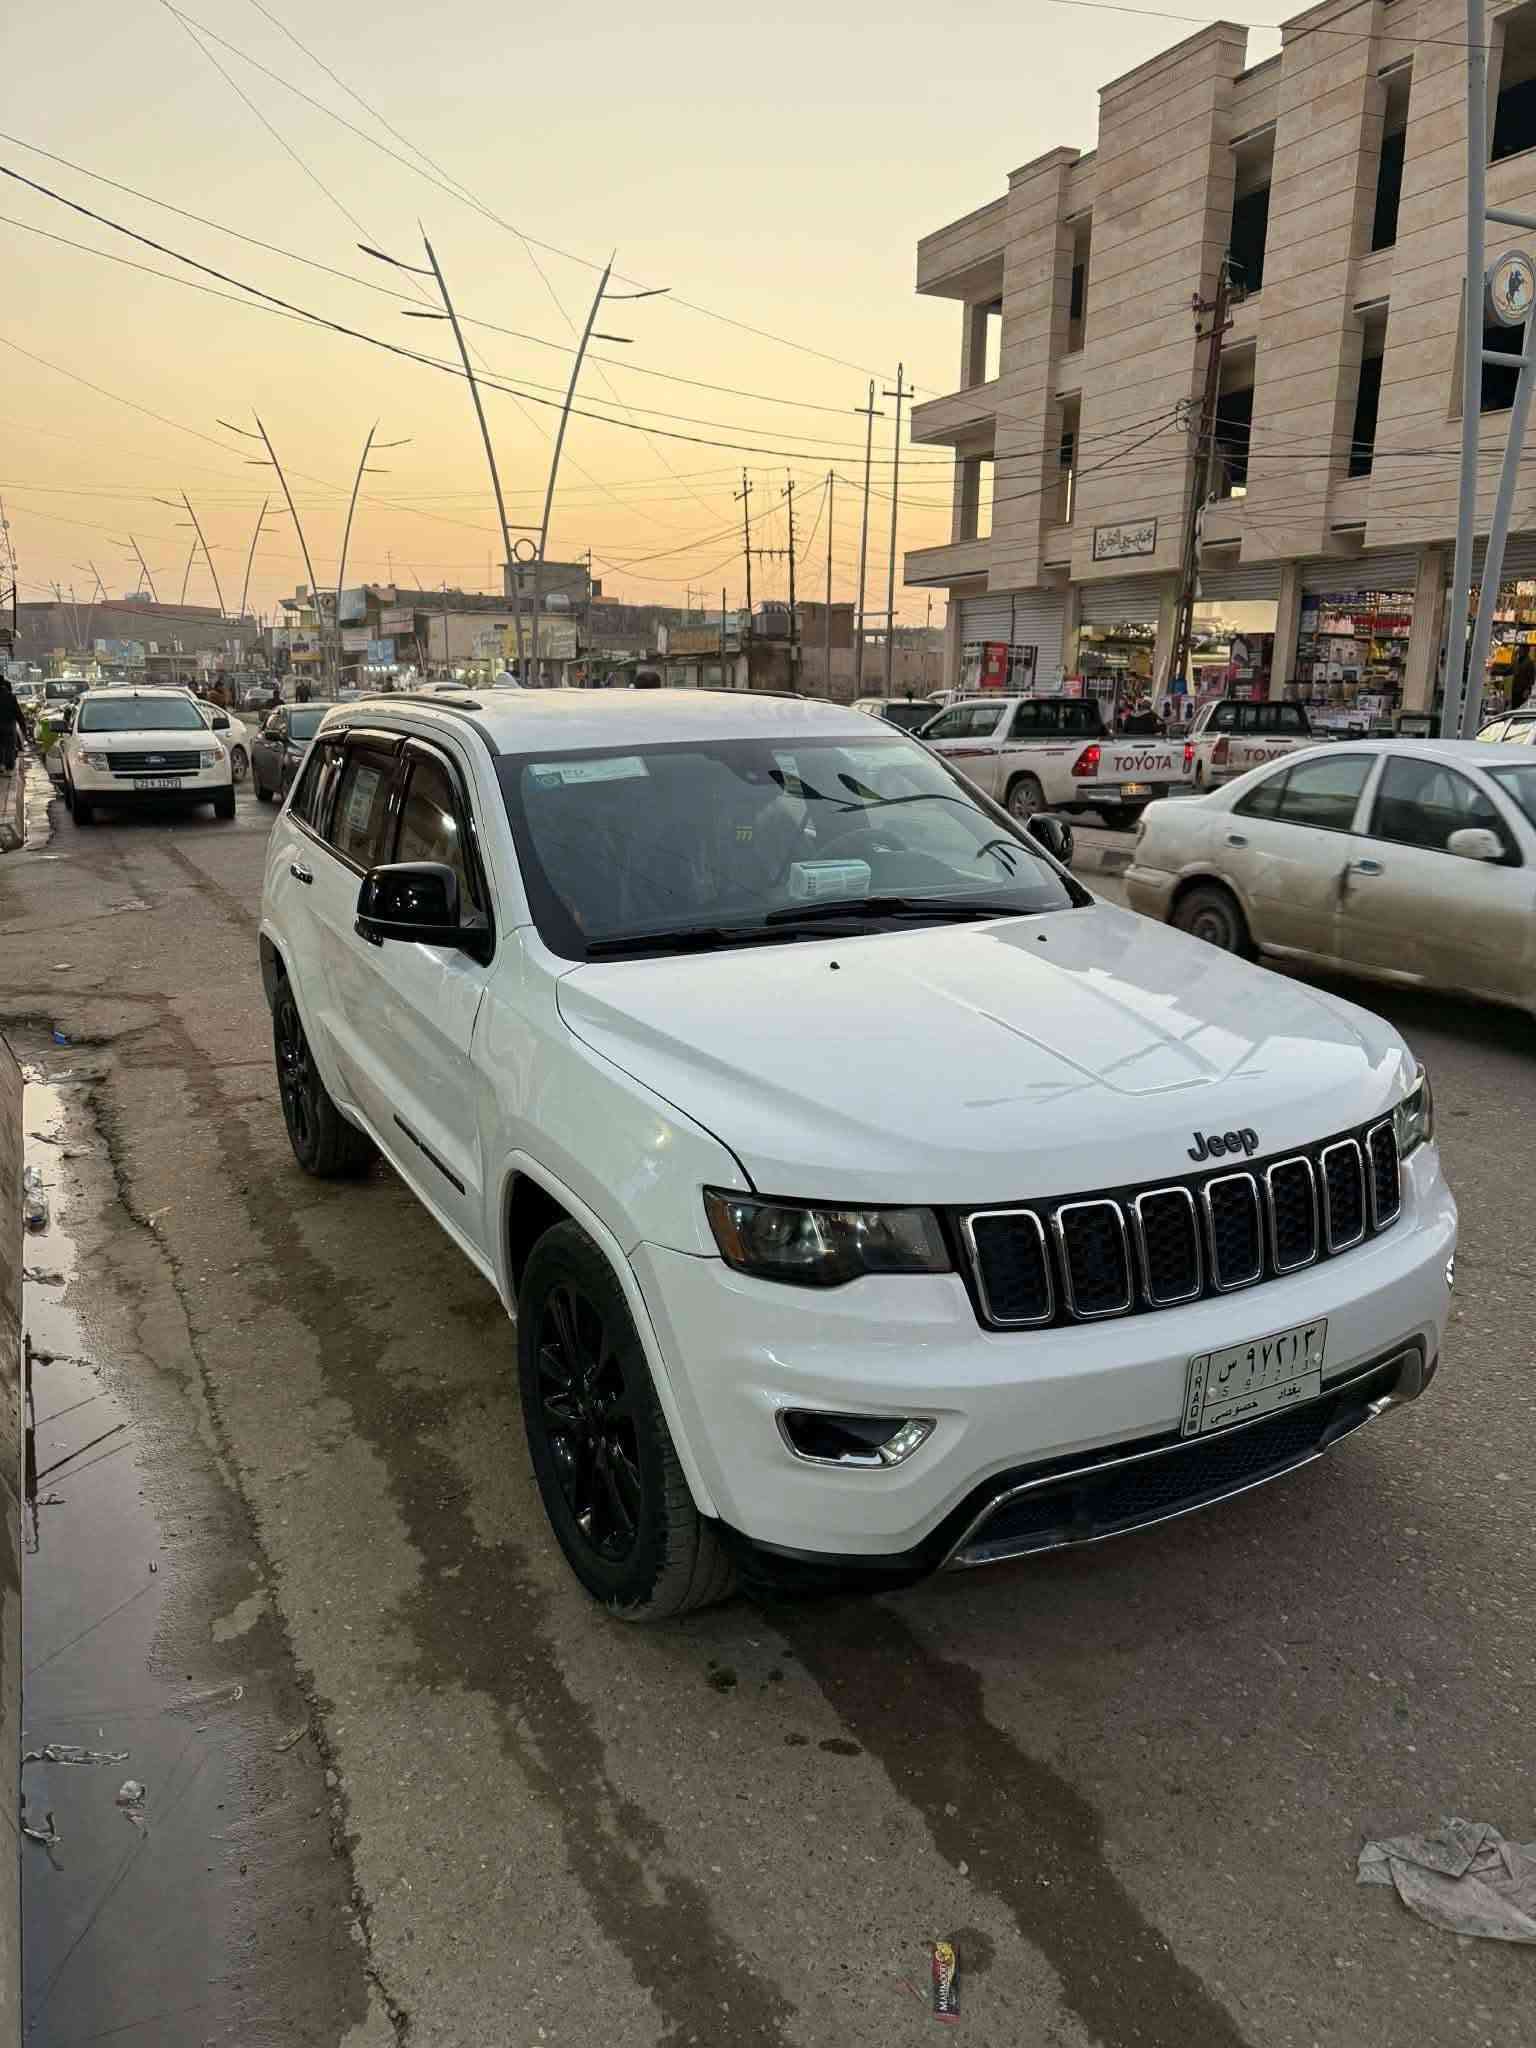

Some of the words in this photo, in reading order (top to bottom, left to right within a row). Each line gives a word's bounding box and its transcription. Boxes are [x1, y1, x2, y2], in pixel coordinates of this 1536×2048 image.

[1113, 755, 1172, 771] TOYOTA
[1187, 1128, 1259, 1161] Jeep
[1190, 1361, 1203, 1418] IRAQ
